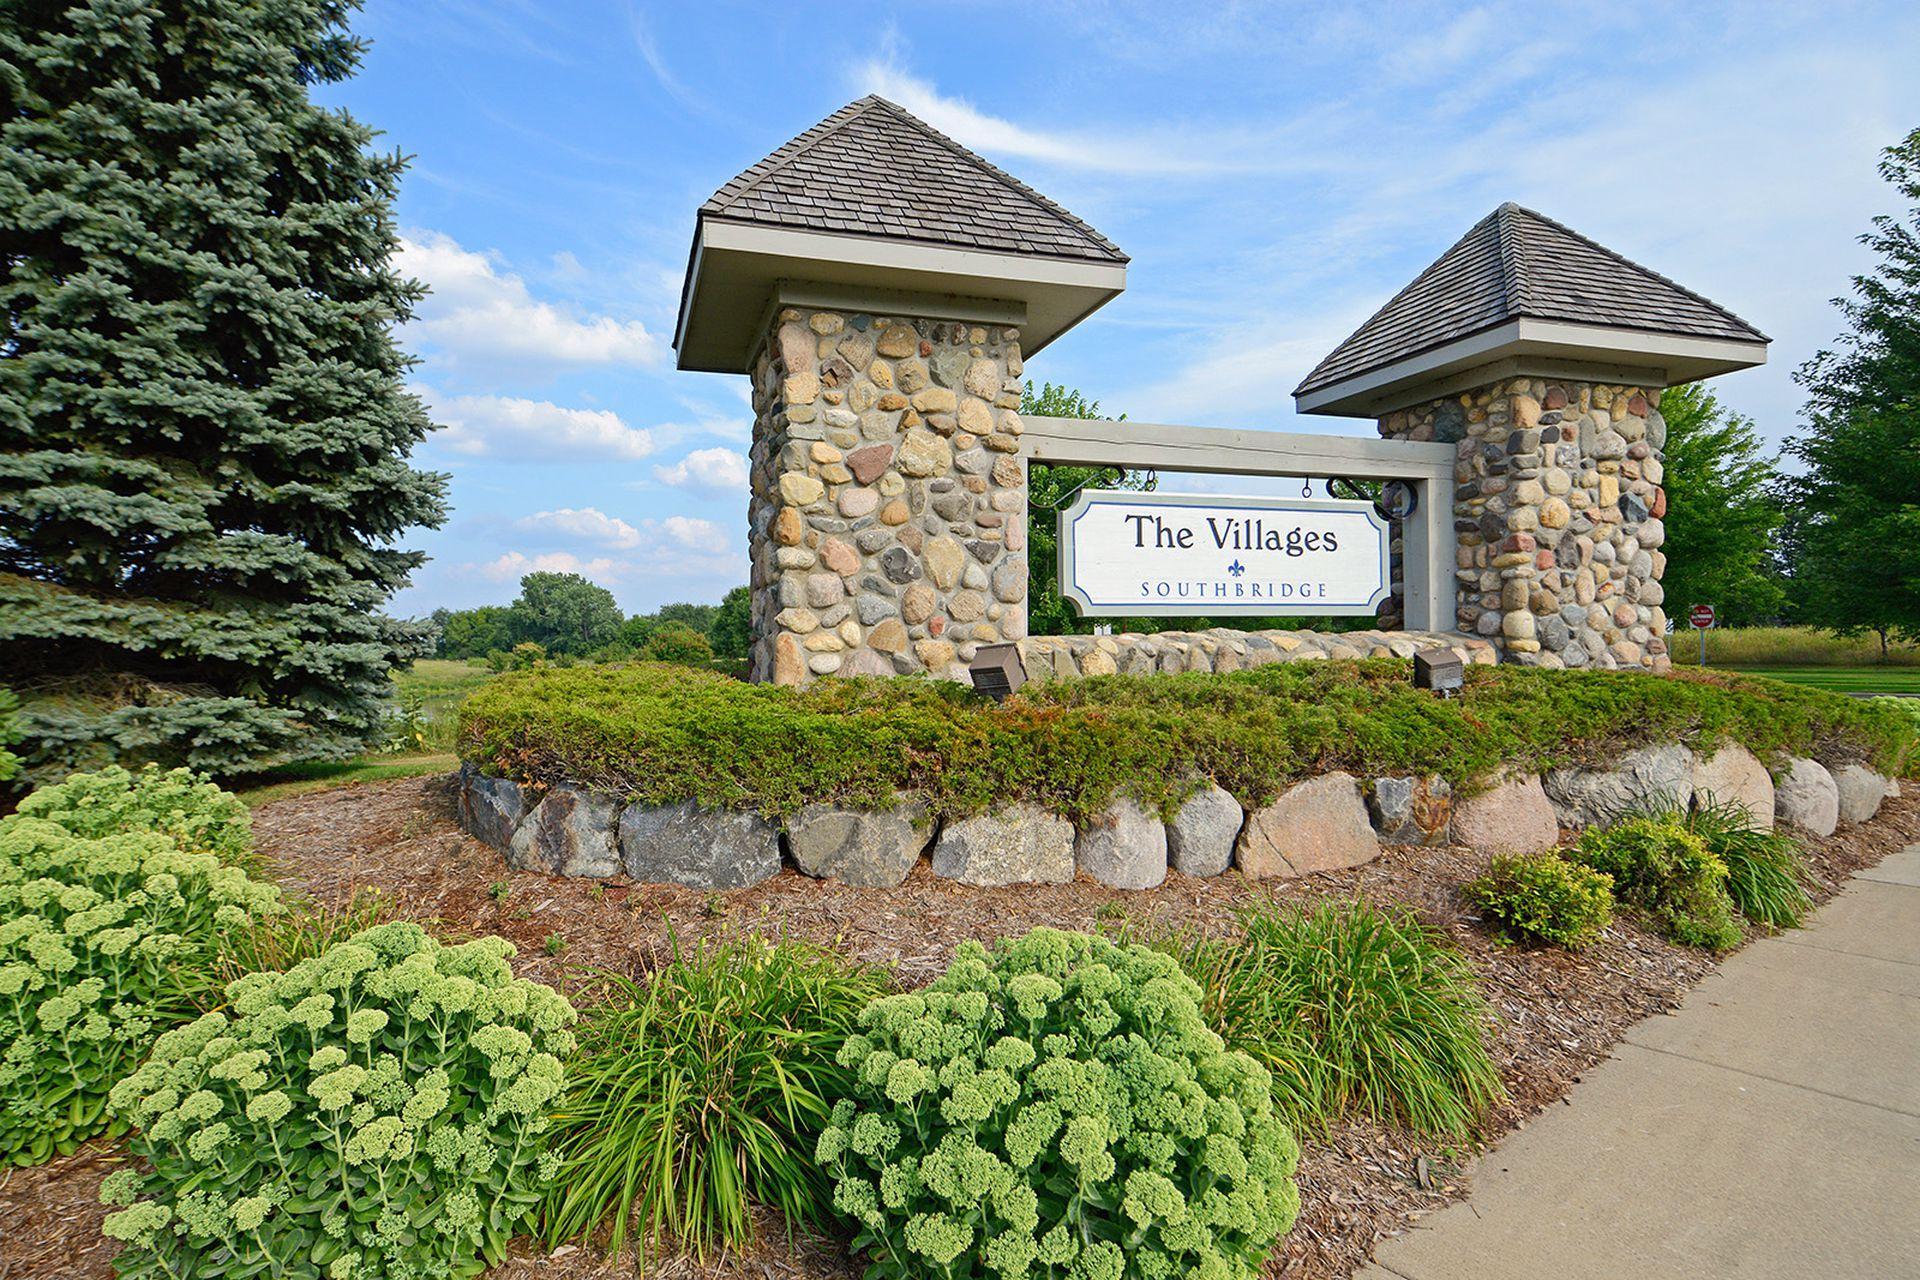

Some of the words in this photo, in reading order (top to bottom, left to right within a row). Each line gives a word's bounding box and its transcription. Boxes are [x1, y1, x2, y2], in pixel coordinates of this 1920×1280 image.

[1125, 514, 1194, 549] The
[1206, 517, 1338, 557] Villages
[1141, 582, 1327, 598] SOUTHBRIDGE
